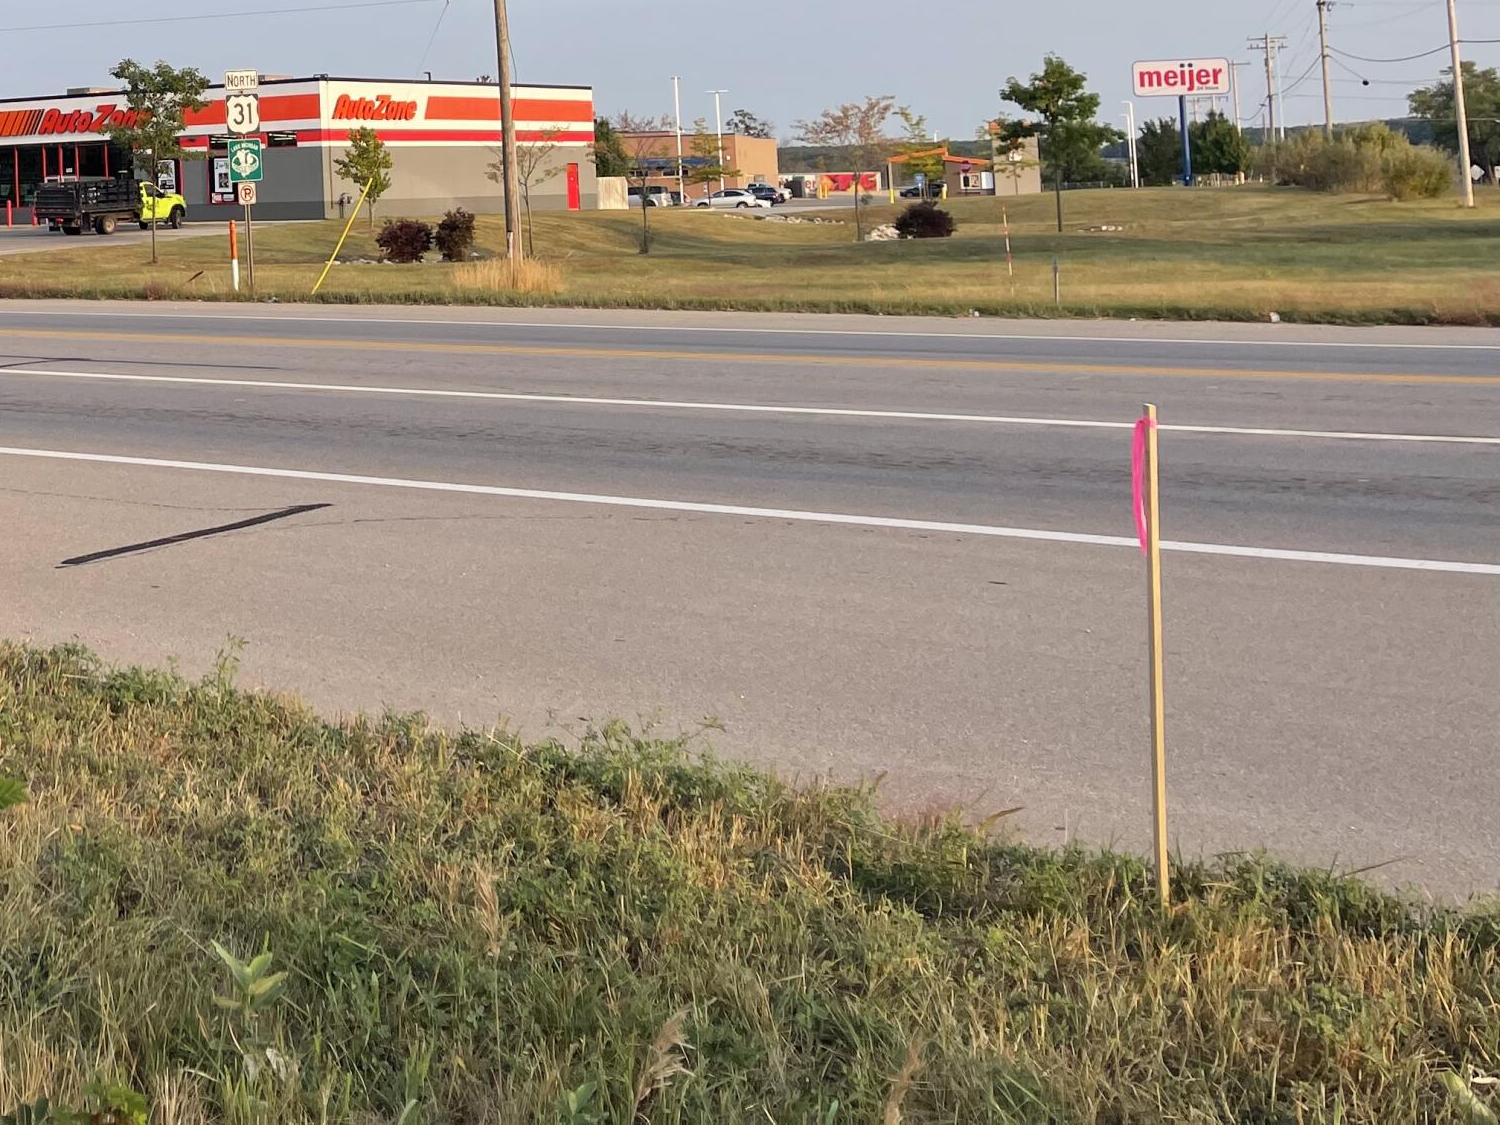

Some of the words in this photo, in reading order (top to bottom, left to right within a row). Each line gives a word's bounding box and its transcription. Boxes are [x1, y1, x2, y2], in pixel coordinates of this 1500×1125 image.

[227, 75, 256, 88] NORTH
[1138, 63, 1222, 91] meijer
[233, 102, 252, 125] 31
[332, 94, 417, 121] AutoZone
